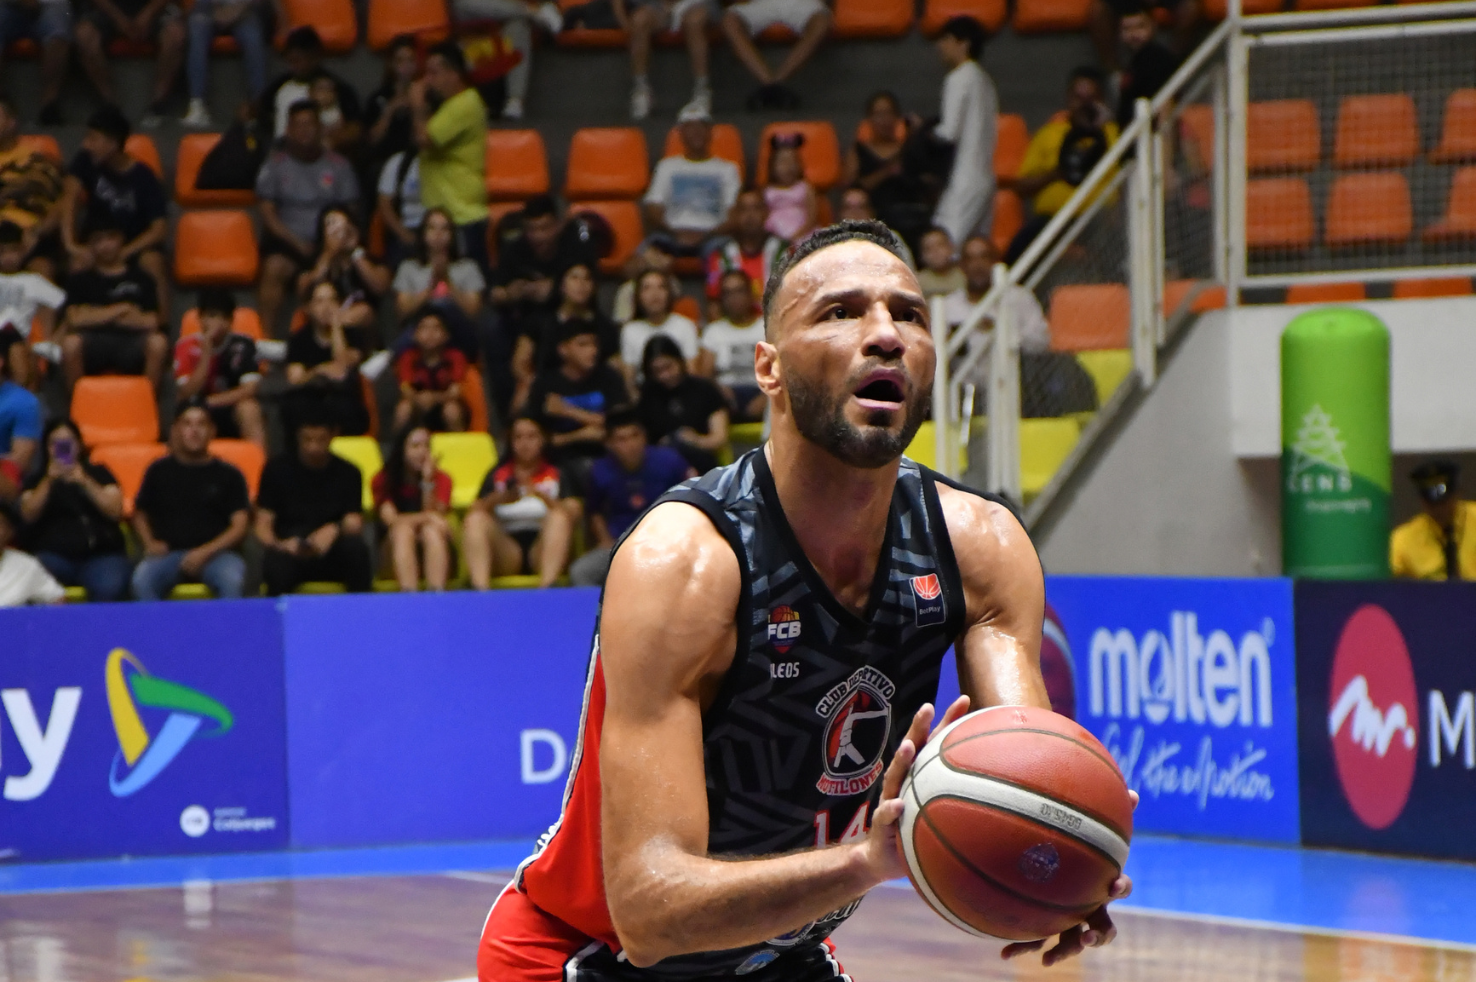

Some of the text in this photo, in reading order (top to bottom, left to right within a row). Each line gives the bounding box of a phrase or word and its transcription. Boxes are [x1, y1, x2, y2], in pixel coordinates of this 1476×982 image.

[767, 620, 801, 640] FCB
[1089, 610, 1273, 728] molten
[816, 684, 848, 717] CLUB
[813, 800, 872, 849] 14
